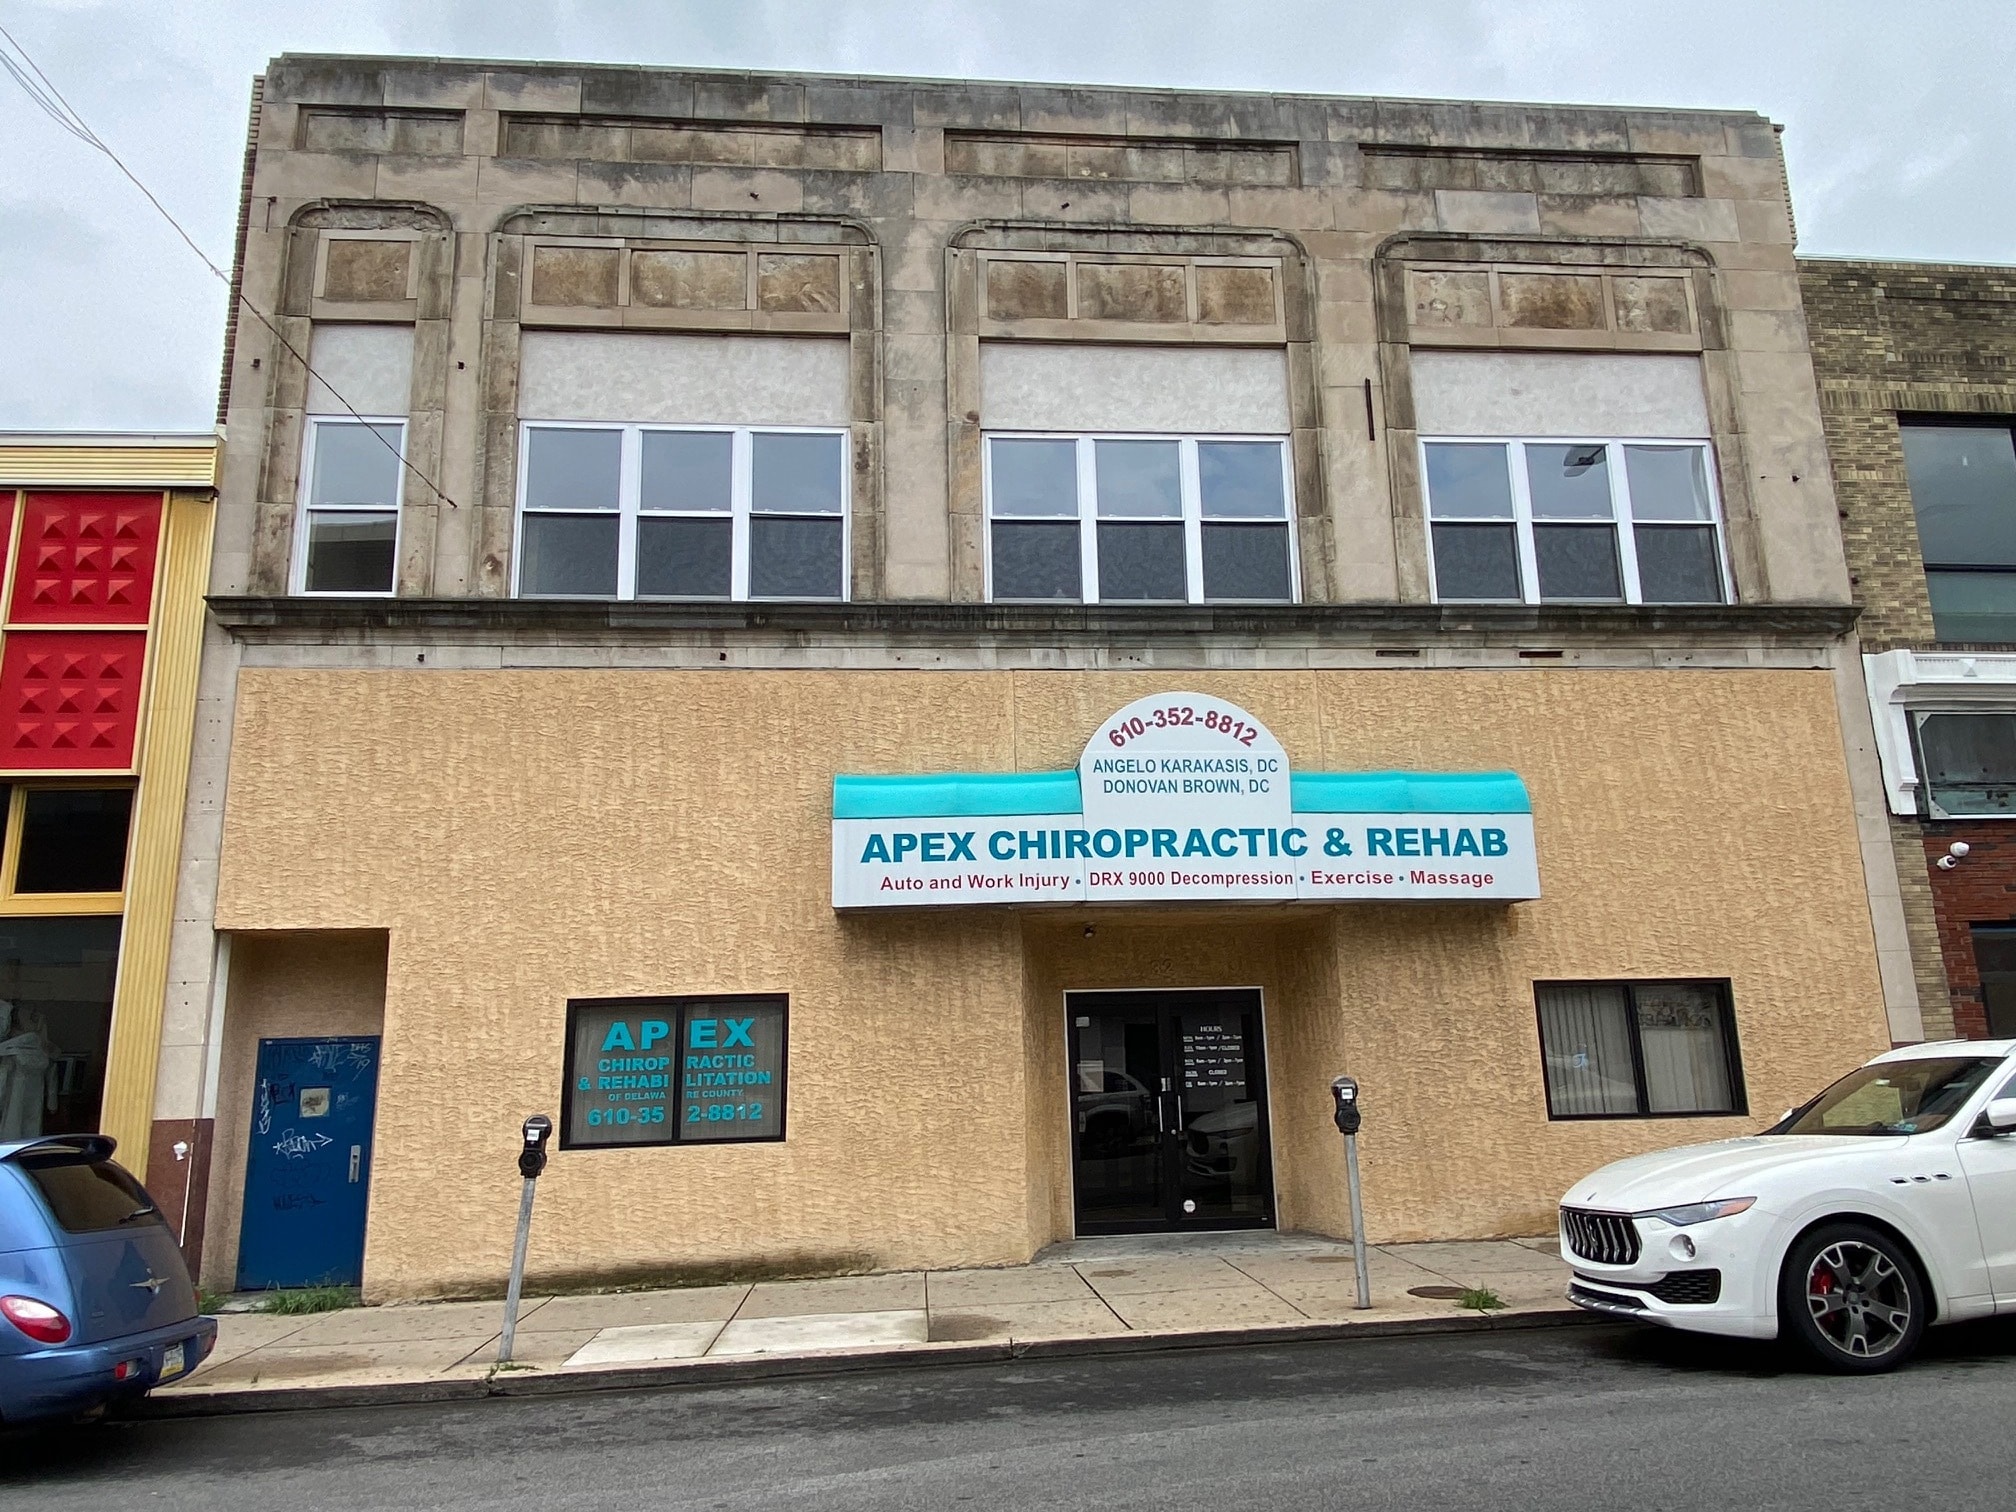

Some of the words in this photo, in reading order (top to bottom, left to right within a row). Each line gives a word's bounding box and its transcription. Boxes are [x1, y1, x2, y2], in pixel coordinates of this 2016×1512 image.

[1108, 707, 1258, 748] 610-352-8812
[1093, 759, 1157, 774] ANGELO
[1161, 759, 1253, 775] KARAKASIS,
[1257, 759, 1279, 773] DC
[1103, 779, 1181, 794] DONOVAN
[1183, 779, 1245, 795] BROWN,
[1249, 779, 1270, 793] DC
[860, 831, 977, 863] APEX
[988, 828, 1309, 861] CHIROPRACTIC
[1323, 828, 1353, 857] &
[1366, 828, 1509, 857] REHAB
[880, 876, 924, 891] Auto
[929, 874, 962, 889] and
[967, 874, 1014, 889] Work
[1019, 872, 1070, 890] Injury
[1090, 872, 1123, 886] DRX
[1129, 871, 1165, 885] 9000
[1171, 871, 1293, 888] Decompression
[1311, 870, 1393, 885] Exercise
[1410, 870, 1494, 888] Massage
[577, 1076, 591, 1091] &
[608, 1092, 621, 1101] OF
